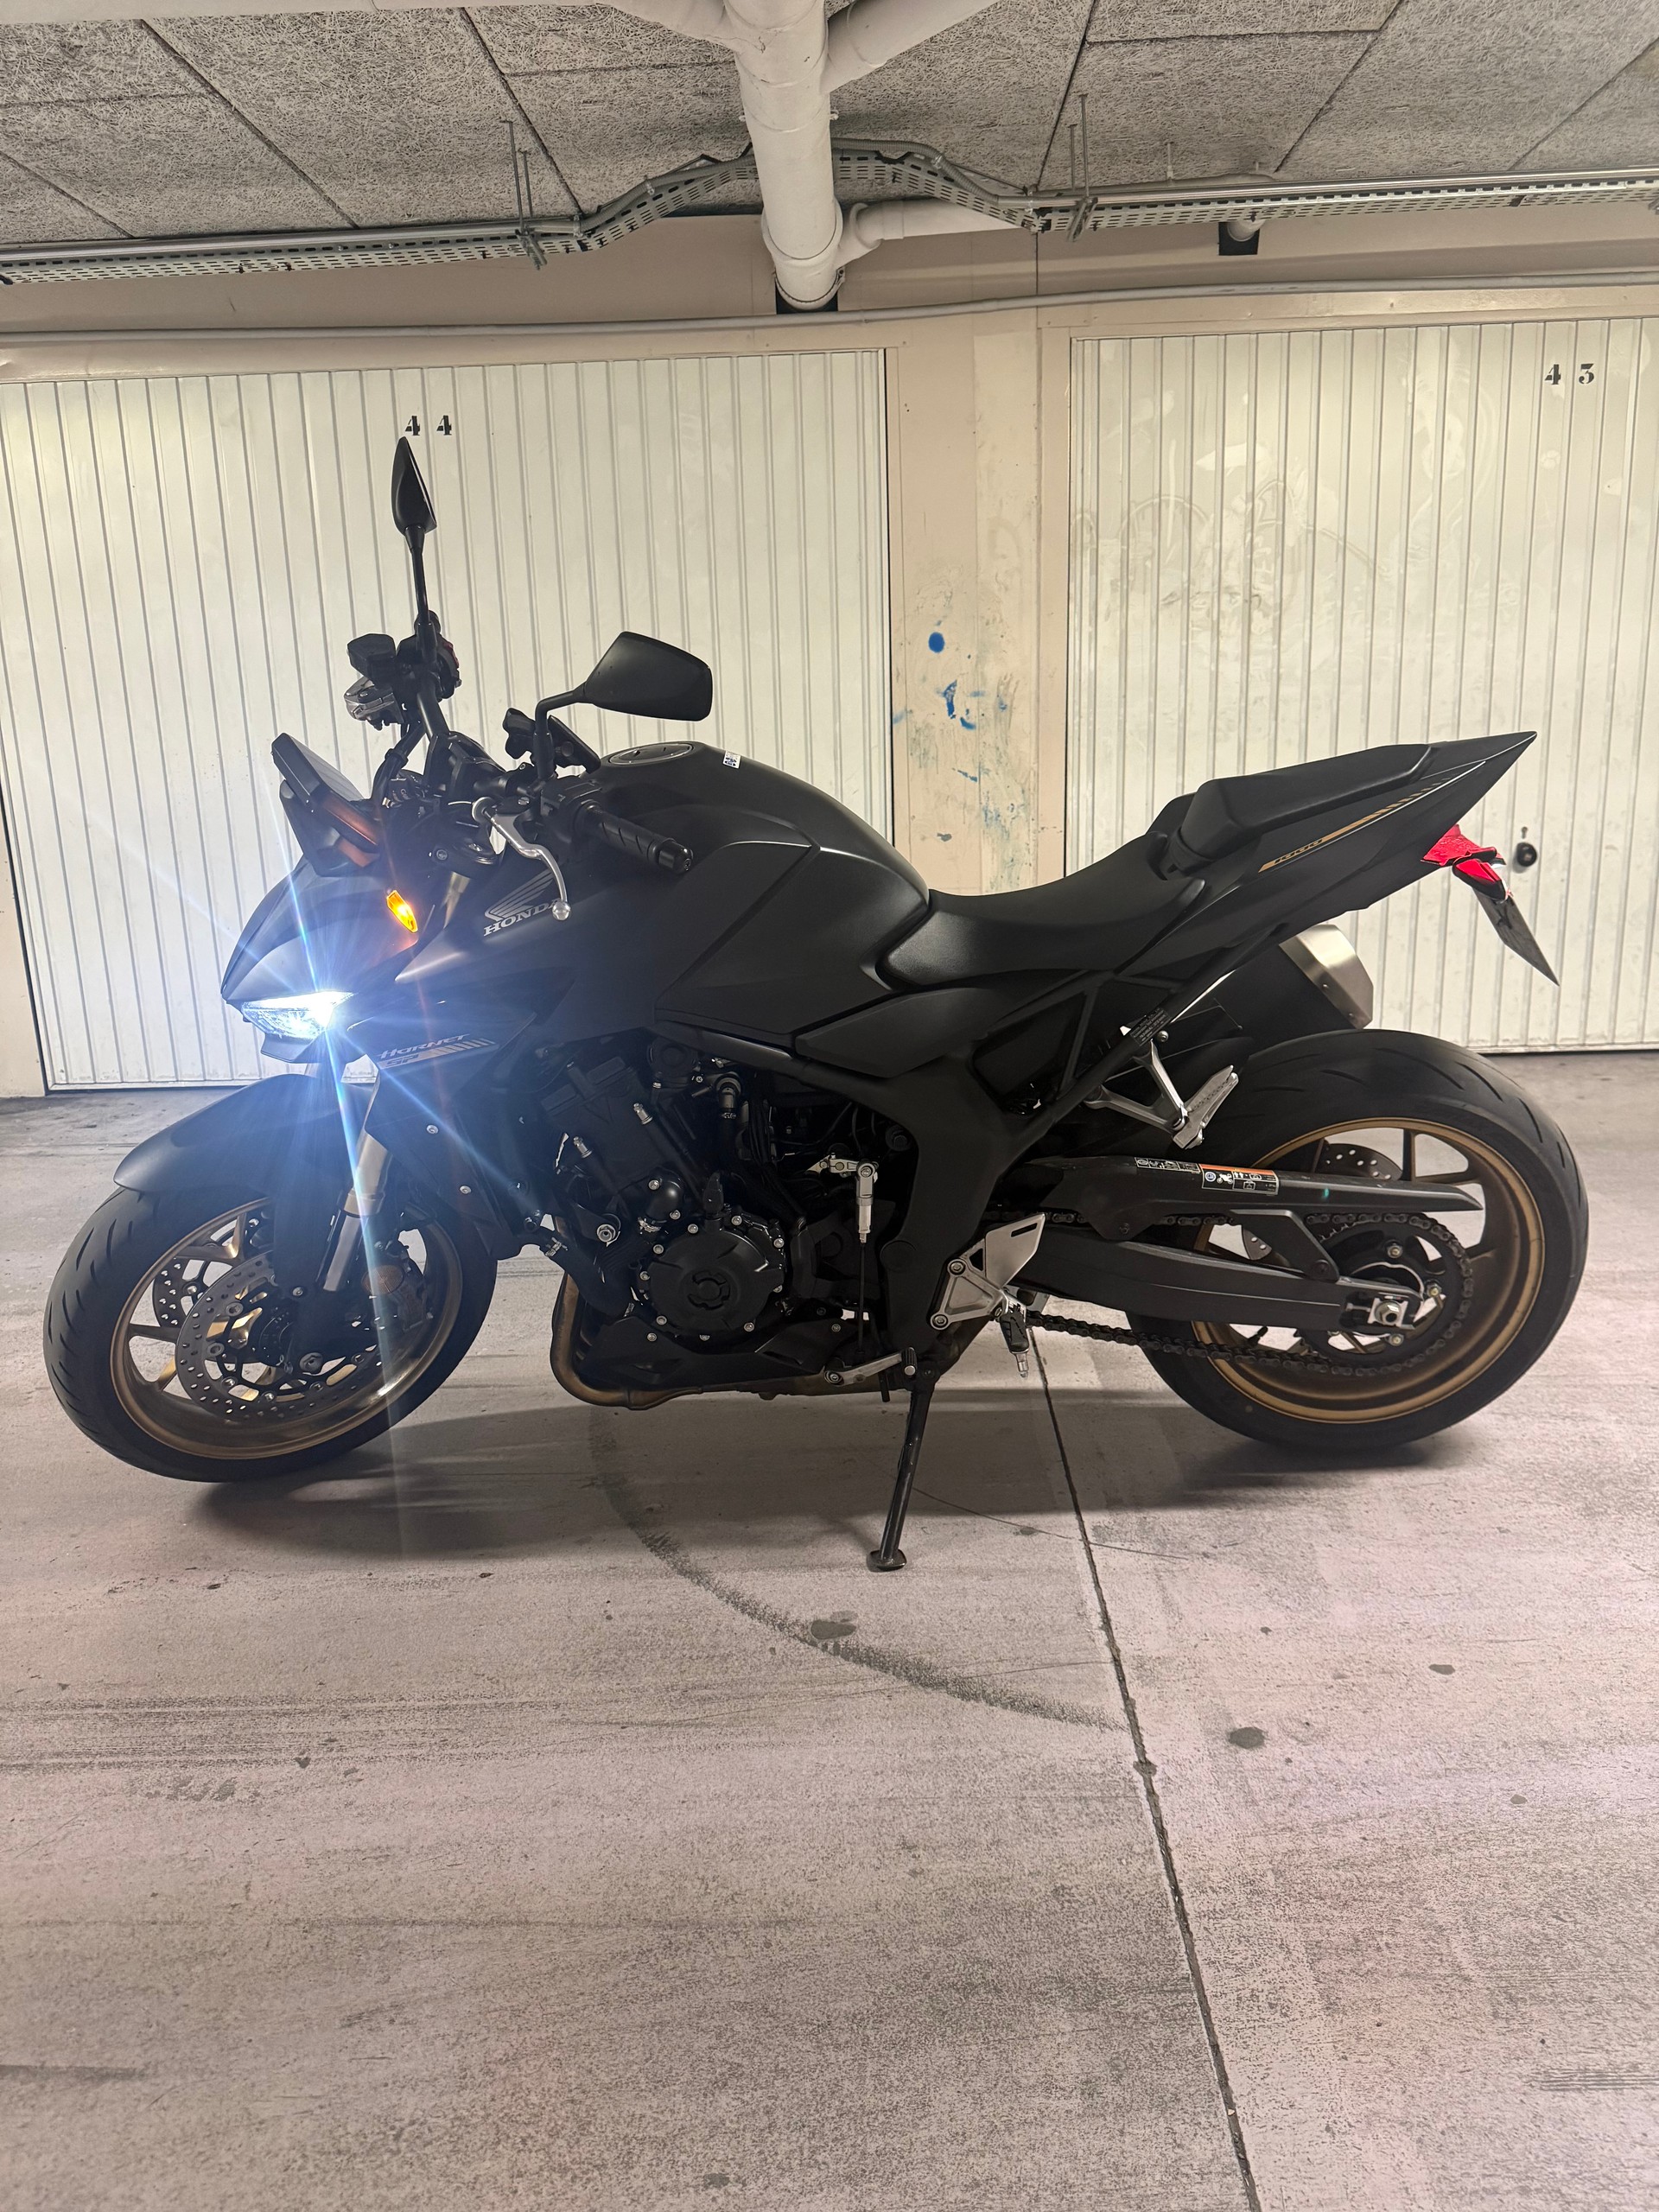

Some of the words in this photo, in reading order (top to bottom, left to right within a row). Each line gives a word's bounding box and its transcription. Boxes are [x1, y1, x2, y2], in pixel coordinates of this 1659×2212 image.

[1544, 363, 1594, 385] 43
[404, 415, 452, 435] 44
[386, 1052, 420, 1067] SP
